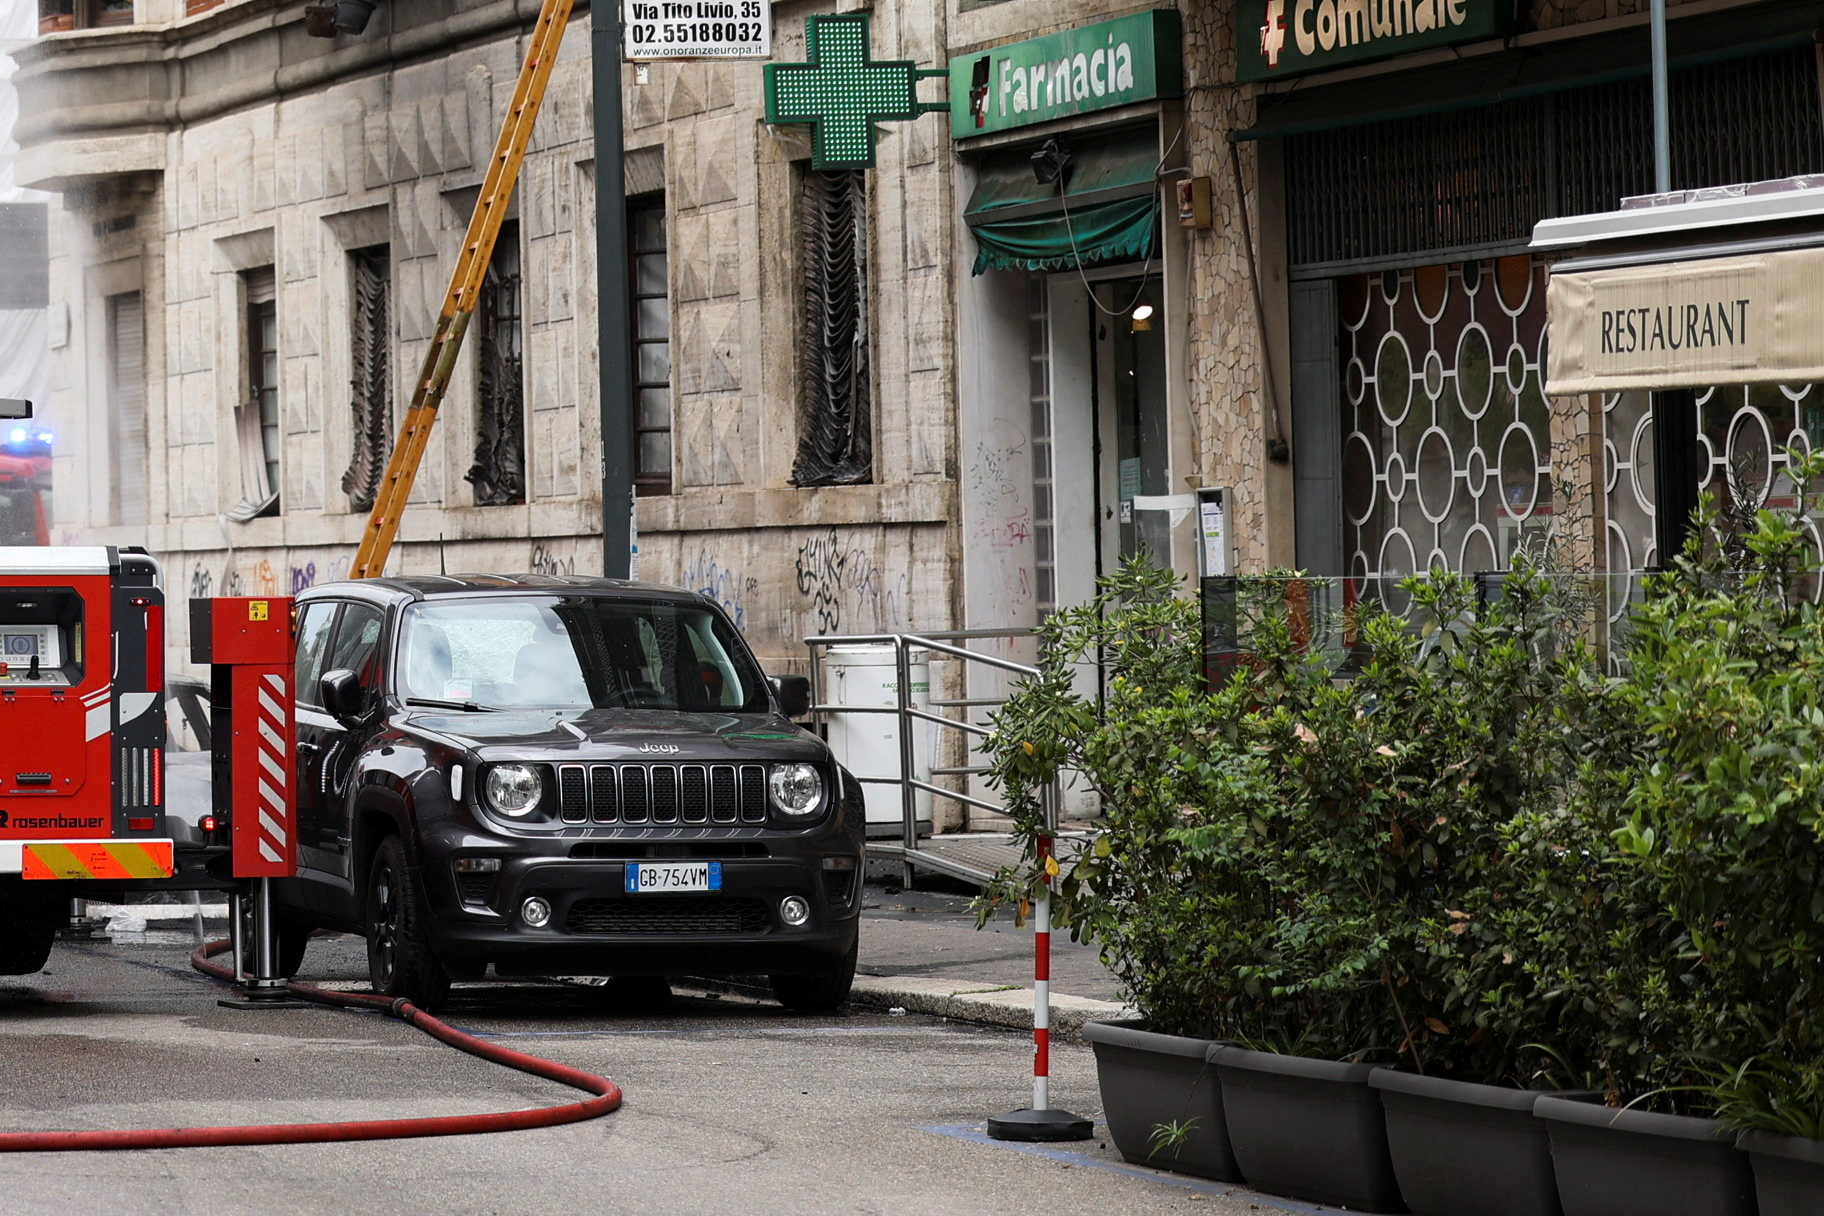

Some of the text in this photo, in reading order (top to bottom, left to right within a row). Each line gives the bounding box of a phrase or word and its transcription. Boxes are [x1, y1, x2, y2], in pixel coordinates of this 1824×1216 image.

[632, 1, 761, 20] Via Tito Livio, 35
[632, 22, 762, 44] 02.55188032
[633, 45, 763, 58] www.onoranzeeuropa.it
[997, 31, 1134, 116] Farmacia
[1601, 299, 1750, 354] RESTAURANT
[639, 743, 680, 754] Jeep
[13, 814, 104, 829] rosenbauer
[640, 869, 657, 887] GB
[662, 868, 707, 887] 754VM
